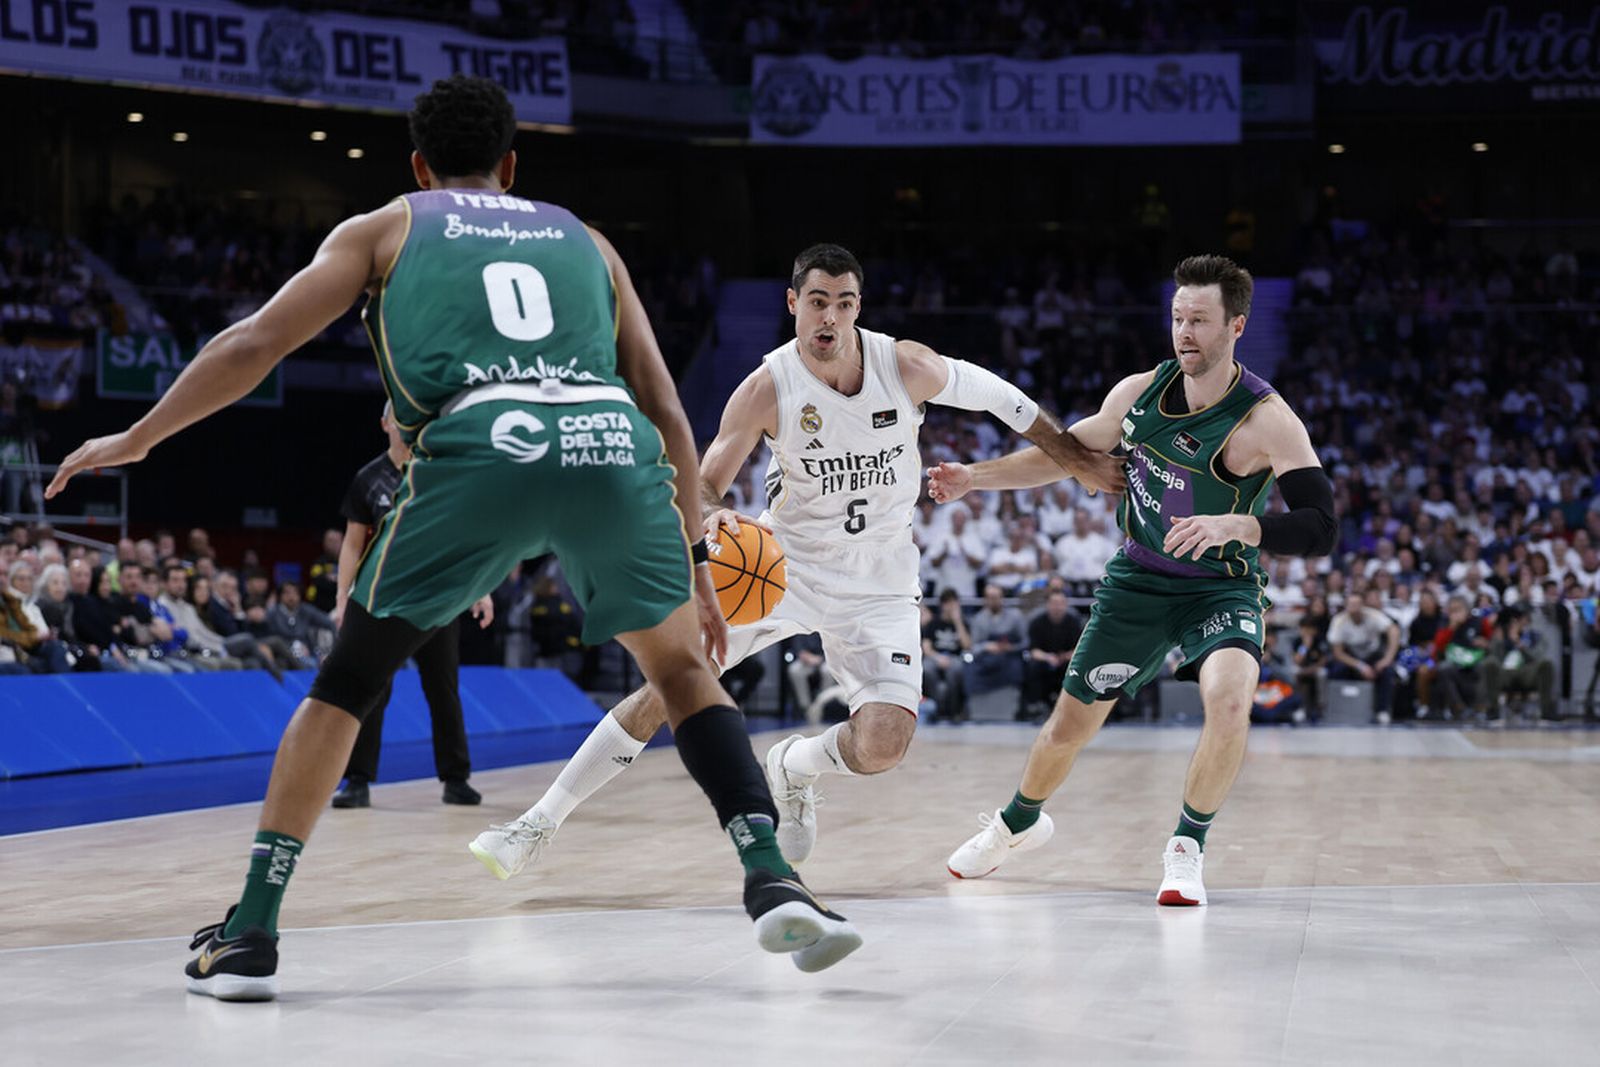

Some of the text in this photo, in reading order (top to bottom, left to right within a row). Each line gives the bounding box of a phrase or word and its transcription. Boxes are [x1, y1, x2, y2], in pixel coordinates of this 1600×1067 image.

[1, 0, 565, 95] LOS OJOS DEL TIGRE
[823, 73, 959, 114] REYES
[989, 70, 1045, 112] DE
[449, 191, 537, 213] TYSON
[482, 261, 555, 342] 0
[463, 355, 607, 386] Andalucía
[558, 412, 633, 432] COSTA
[560, 431, 635, 449] DEL SOL
[561, 447, 635, 467] MÁLAGA
[800, 443, 905, 478] Emirates
[822, 467, 897, 496] FLY BETTER
[844, 498, 868, 535] 6
